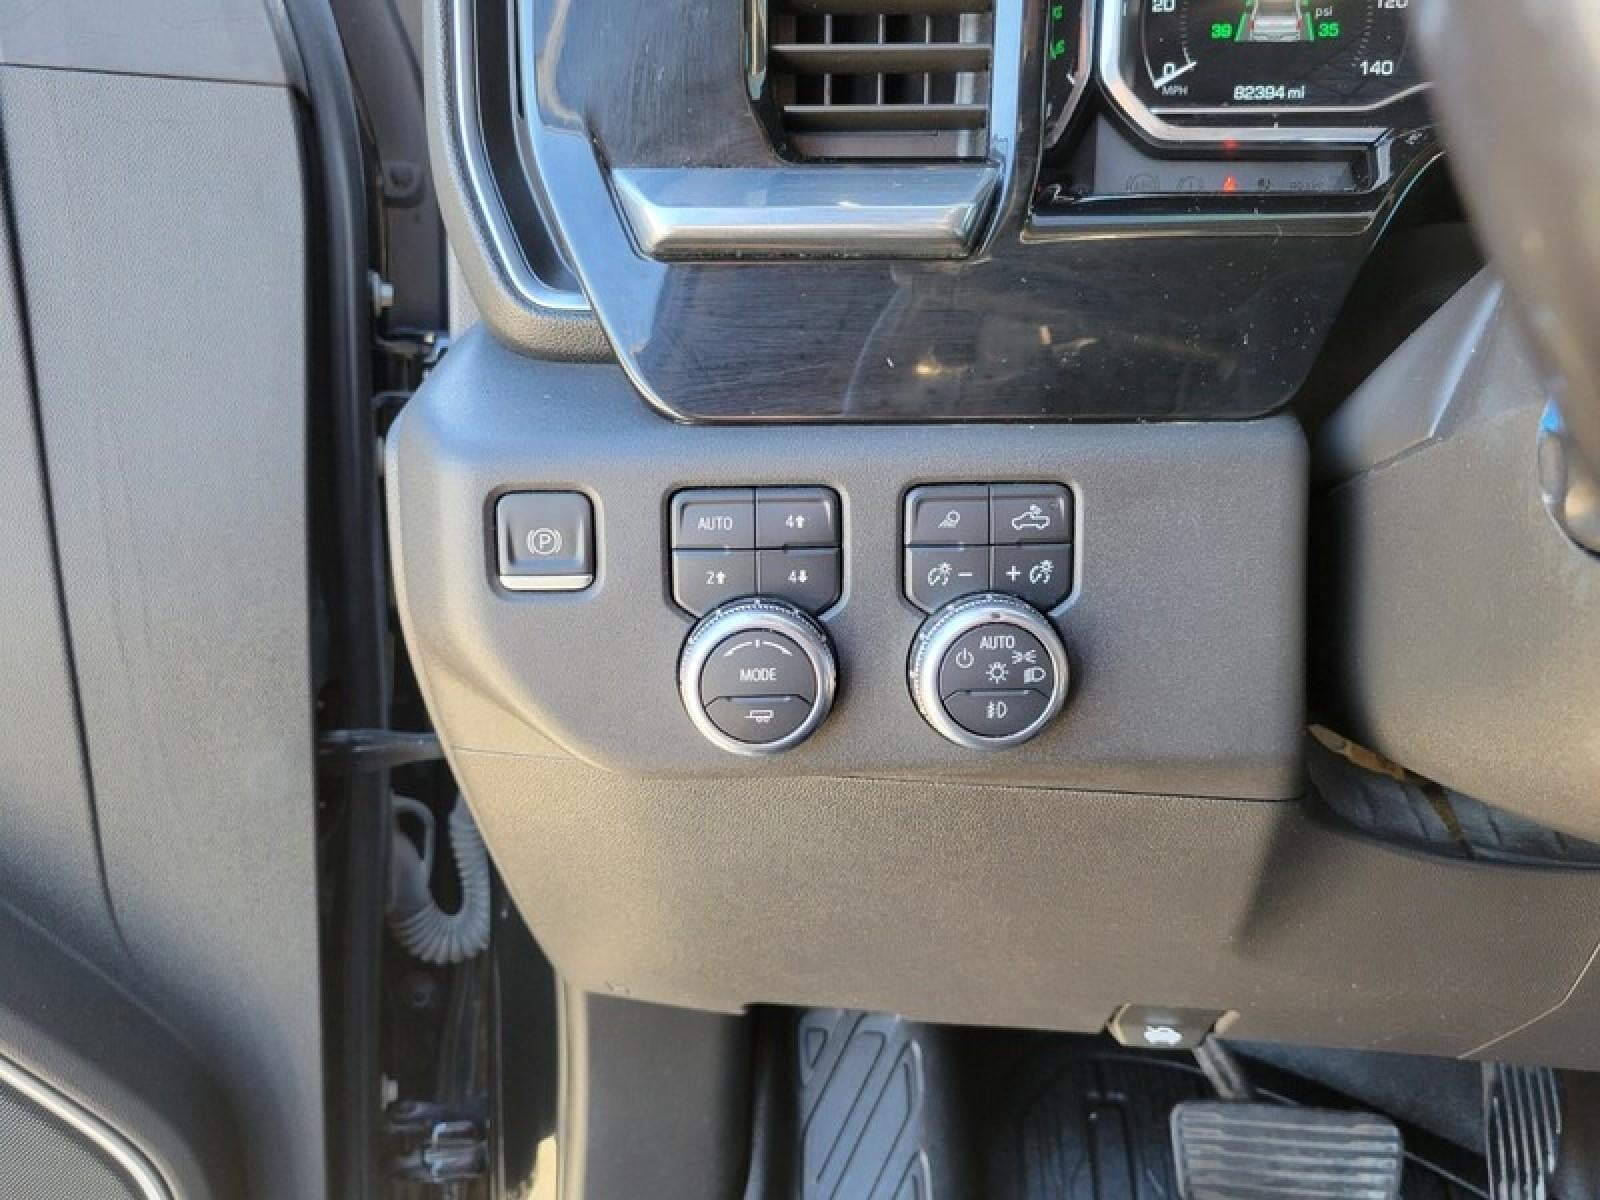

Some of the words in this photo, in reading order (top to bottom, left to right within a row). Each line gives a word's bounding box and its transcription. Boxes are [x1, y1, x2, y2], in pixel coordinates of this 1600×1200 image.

[1315, 6, 1333, 19] psi
[1318, 22, 1338, 37] 35
[1360, 60, 1393, 76] 140
[1162, 85, 1188, 96] MPH
[1234, 85, 1285, 100] 82394
[1287, 85, 1304, 99] mi
[698, 517, 732, 530] AUTO
[980, 636, 1016, 650] AUTO
[740, 668, 776, 681] MODE
